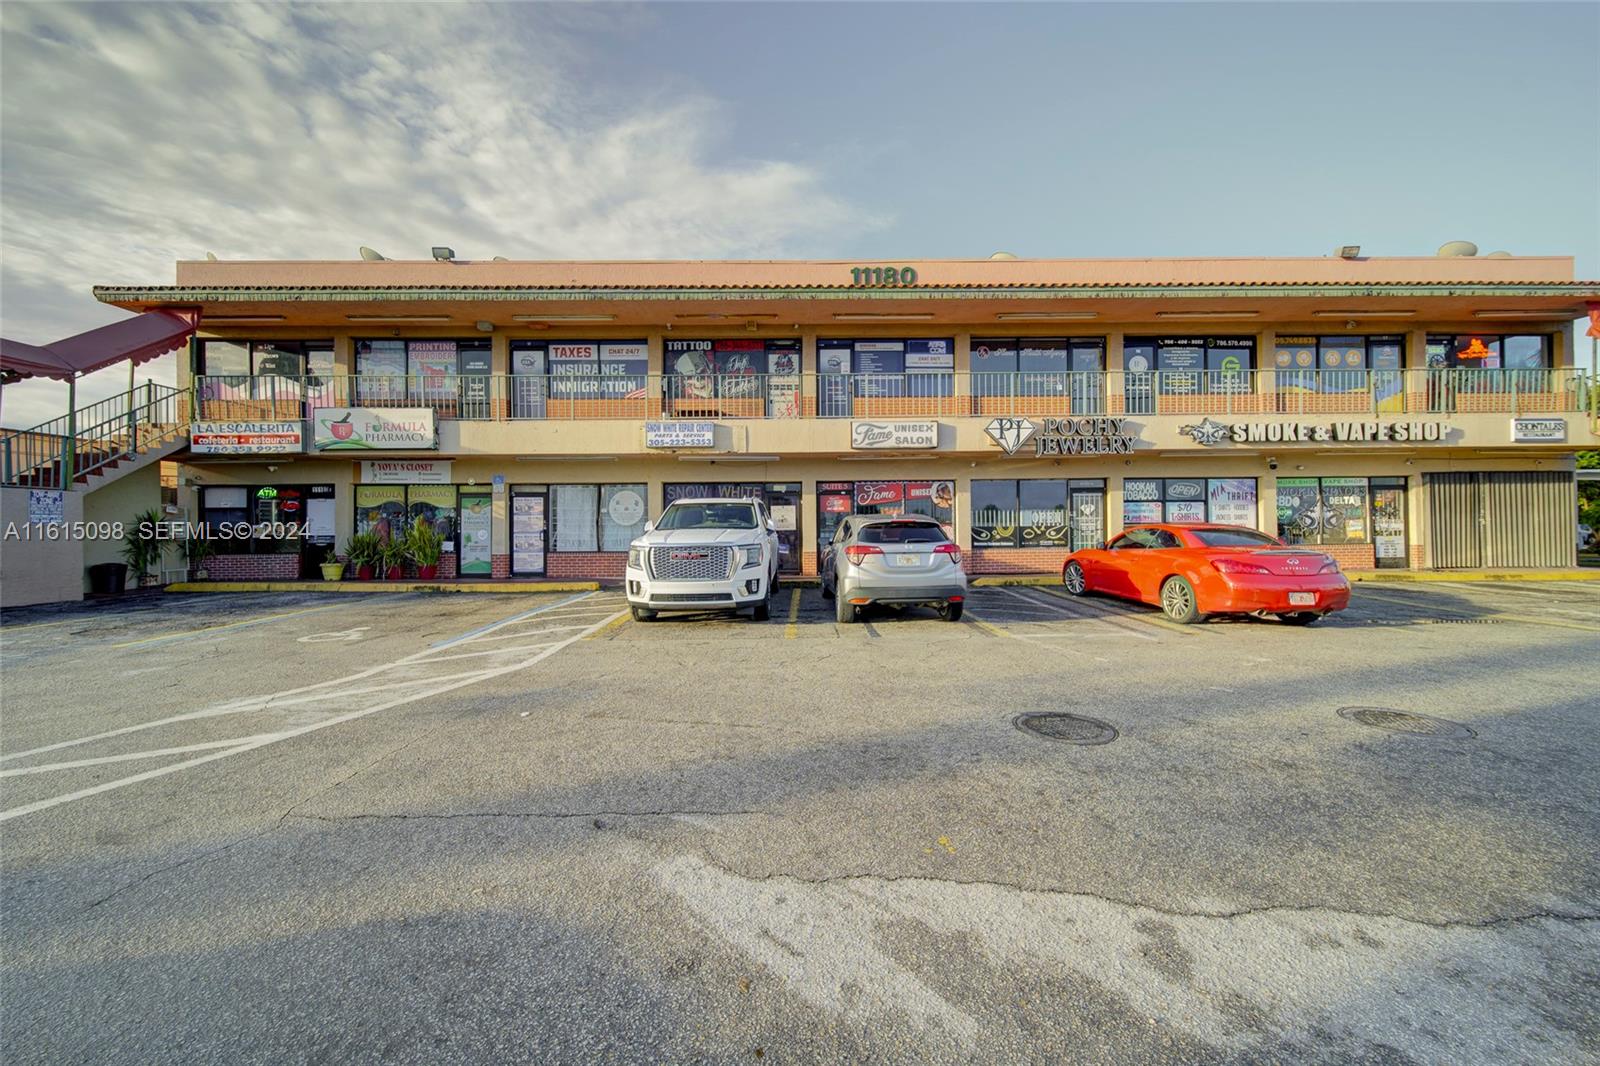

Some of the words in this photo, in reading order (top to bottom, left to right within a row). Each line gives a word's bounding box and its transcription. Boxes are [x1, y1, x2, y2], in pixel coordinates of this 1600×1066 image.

[850, 266, 918, 285] 11180
[409, 342, 457, 351] PRINTING
[666, 340, 712, 351] TATTOO
[552, 346, 592, 358] TAXES
[552, 363, 626, 376] INSURANCE
[197, 423, 214, 434] LA
[219, 423, 295, 434] ESCALERITA
[365, 421, 427, 433] FORMULA
[894, 424, 934, 432] UNISEX
[1042, 417, 1127, 436] POCHY
[1232, 422, 1309, 442] SMOKE
[1314, 425, 1330, 441] &
[1334, 422, 1389, 441] VAPE
[1395, 422, 1452, 441] SHOP
[1515, 422, 1564, 431] CHONTALES
[198, 435, 238, 444] cafeteria
[249, 435, 296, 444] restaurant
[365, 432, 427, 441] PHARMACY
[853, 423, 894, 446] Fame
[895, 436, 933, 445] SALON
[1034, 436, 1137, 457] JEWELRY
[405, 463, 434, 472] CLOSET
[1125, 481, 1156, 491] HOOKAH
[1171, 484, 1197, 497] OPEN
[256, 489, 277, 498] ATM
[666, 484, 708, 500] SNOW
[717, 486, 762, 500] WHITE
[857, 484, 896, 506] Fame
[1123, 490, 1158, 500] TOBACCO
[1227, 491, 1255, 501] THRIFT
[1277, 495, 1292, 507] BD
[1329, 496, 1356, 505] DELTA
